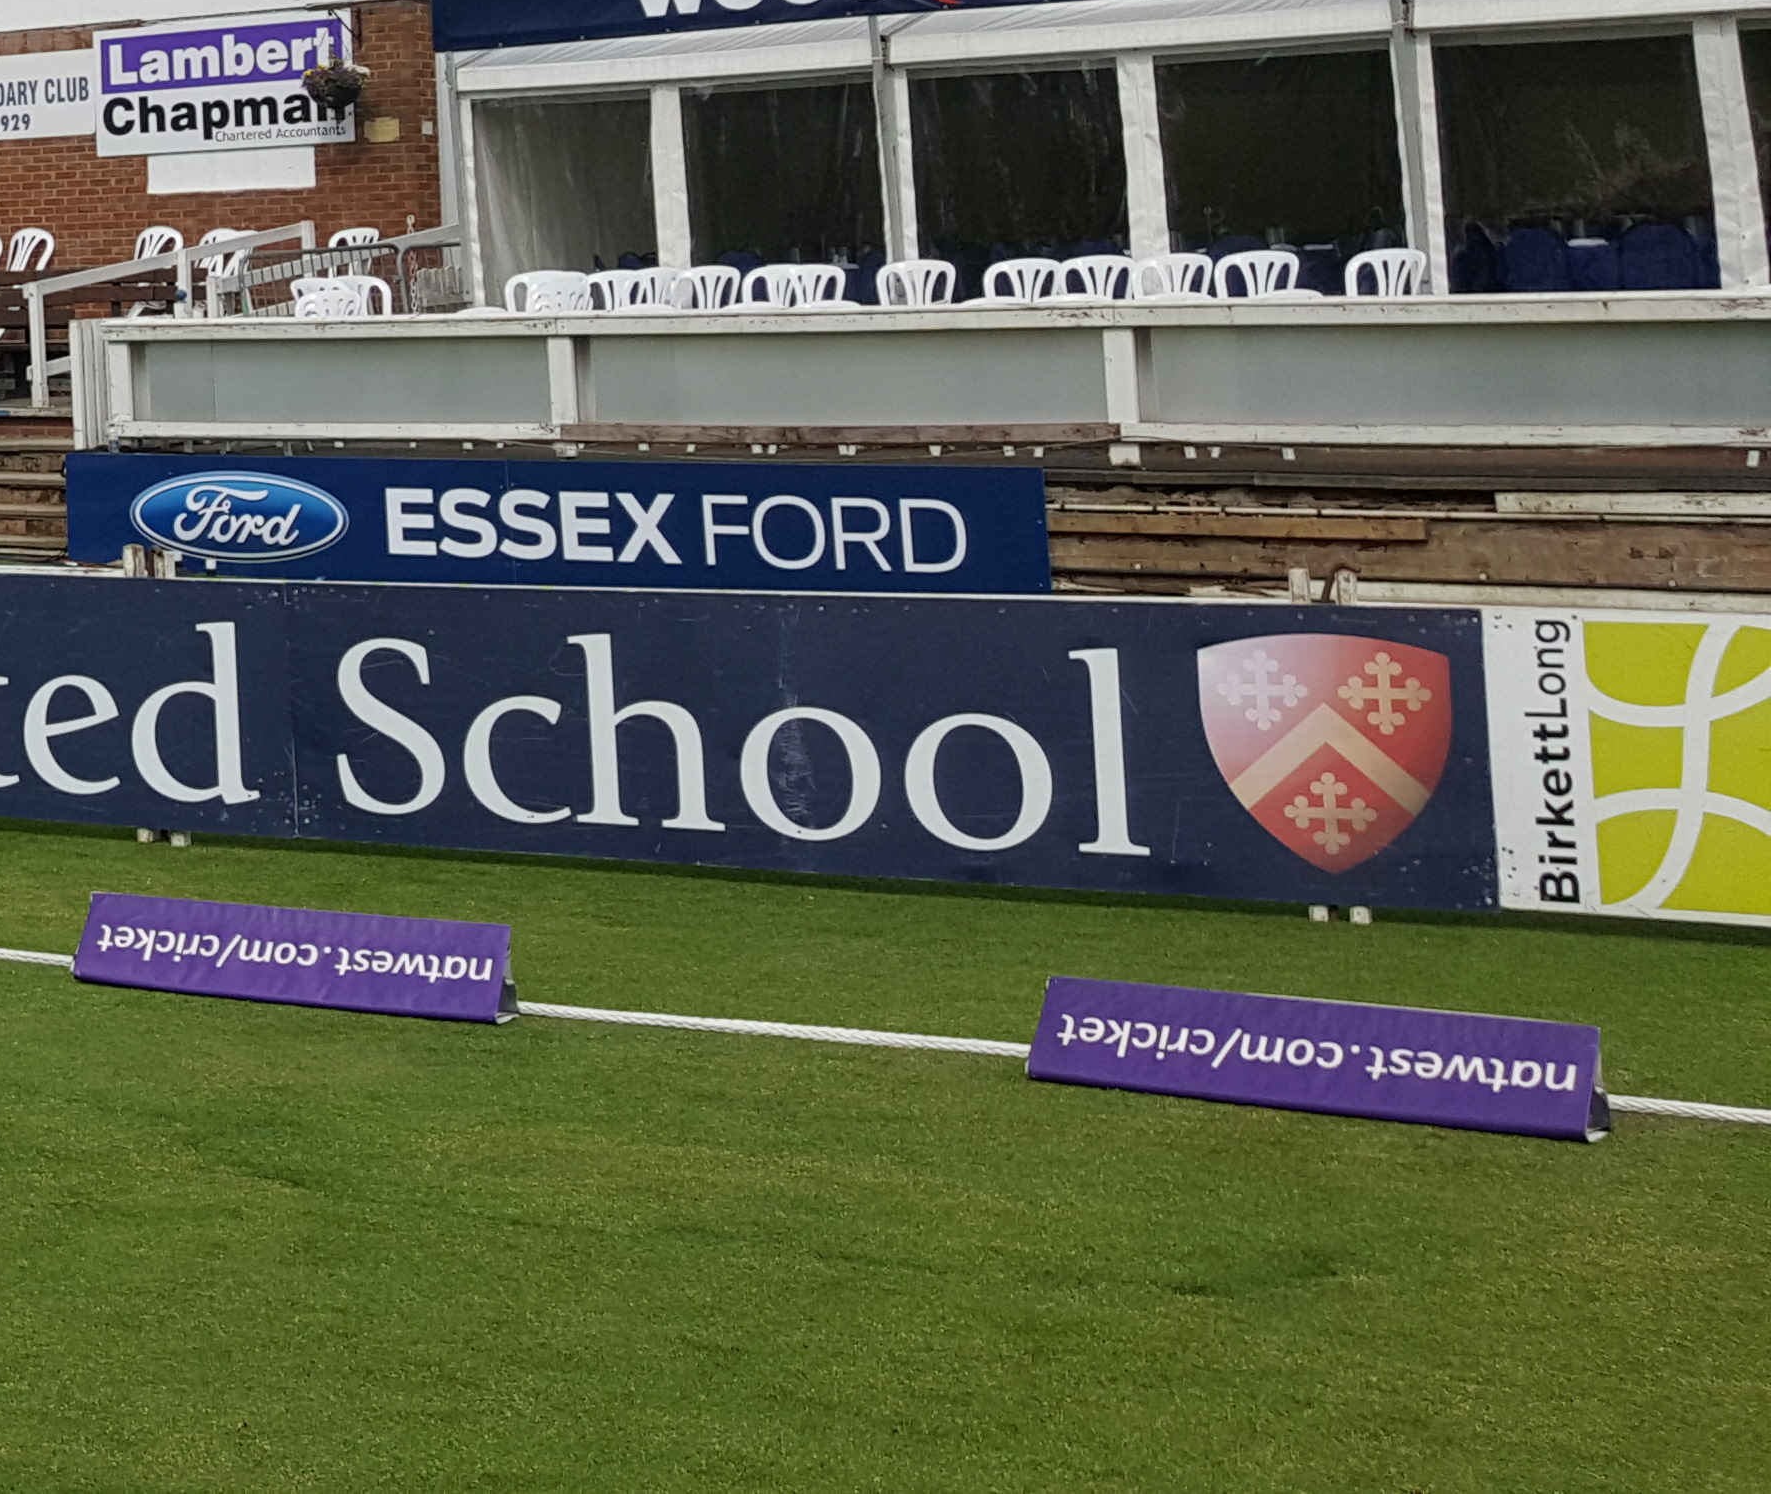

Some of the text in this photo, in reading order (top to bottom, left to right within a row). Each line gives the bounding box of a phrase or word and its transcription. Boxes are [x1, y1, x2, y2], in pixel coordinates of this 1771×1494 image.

[44, 76, 89, 104] CLUB
[109, 26, 335, 87] Lambert
[215, 125, 347, 143] Chartered Accountants
[173, 482, 300, 549] Ford
[385, 487, 968, 574] ESSEX FORD
[335, 633, 1151, 856] School
[1524, 618, 1582, 906] BirkettLong
[97, 921, 494, 984] natwest.com/cricket
[1057, 1013, 1578, 1093] natwest.com/cricket
